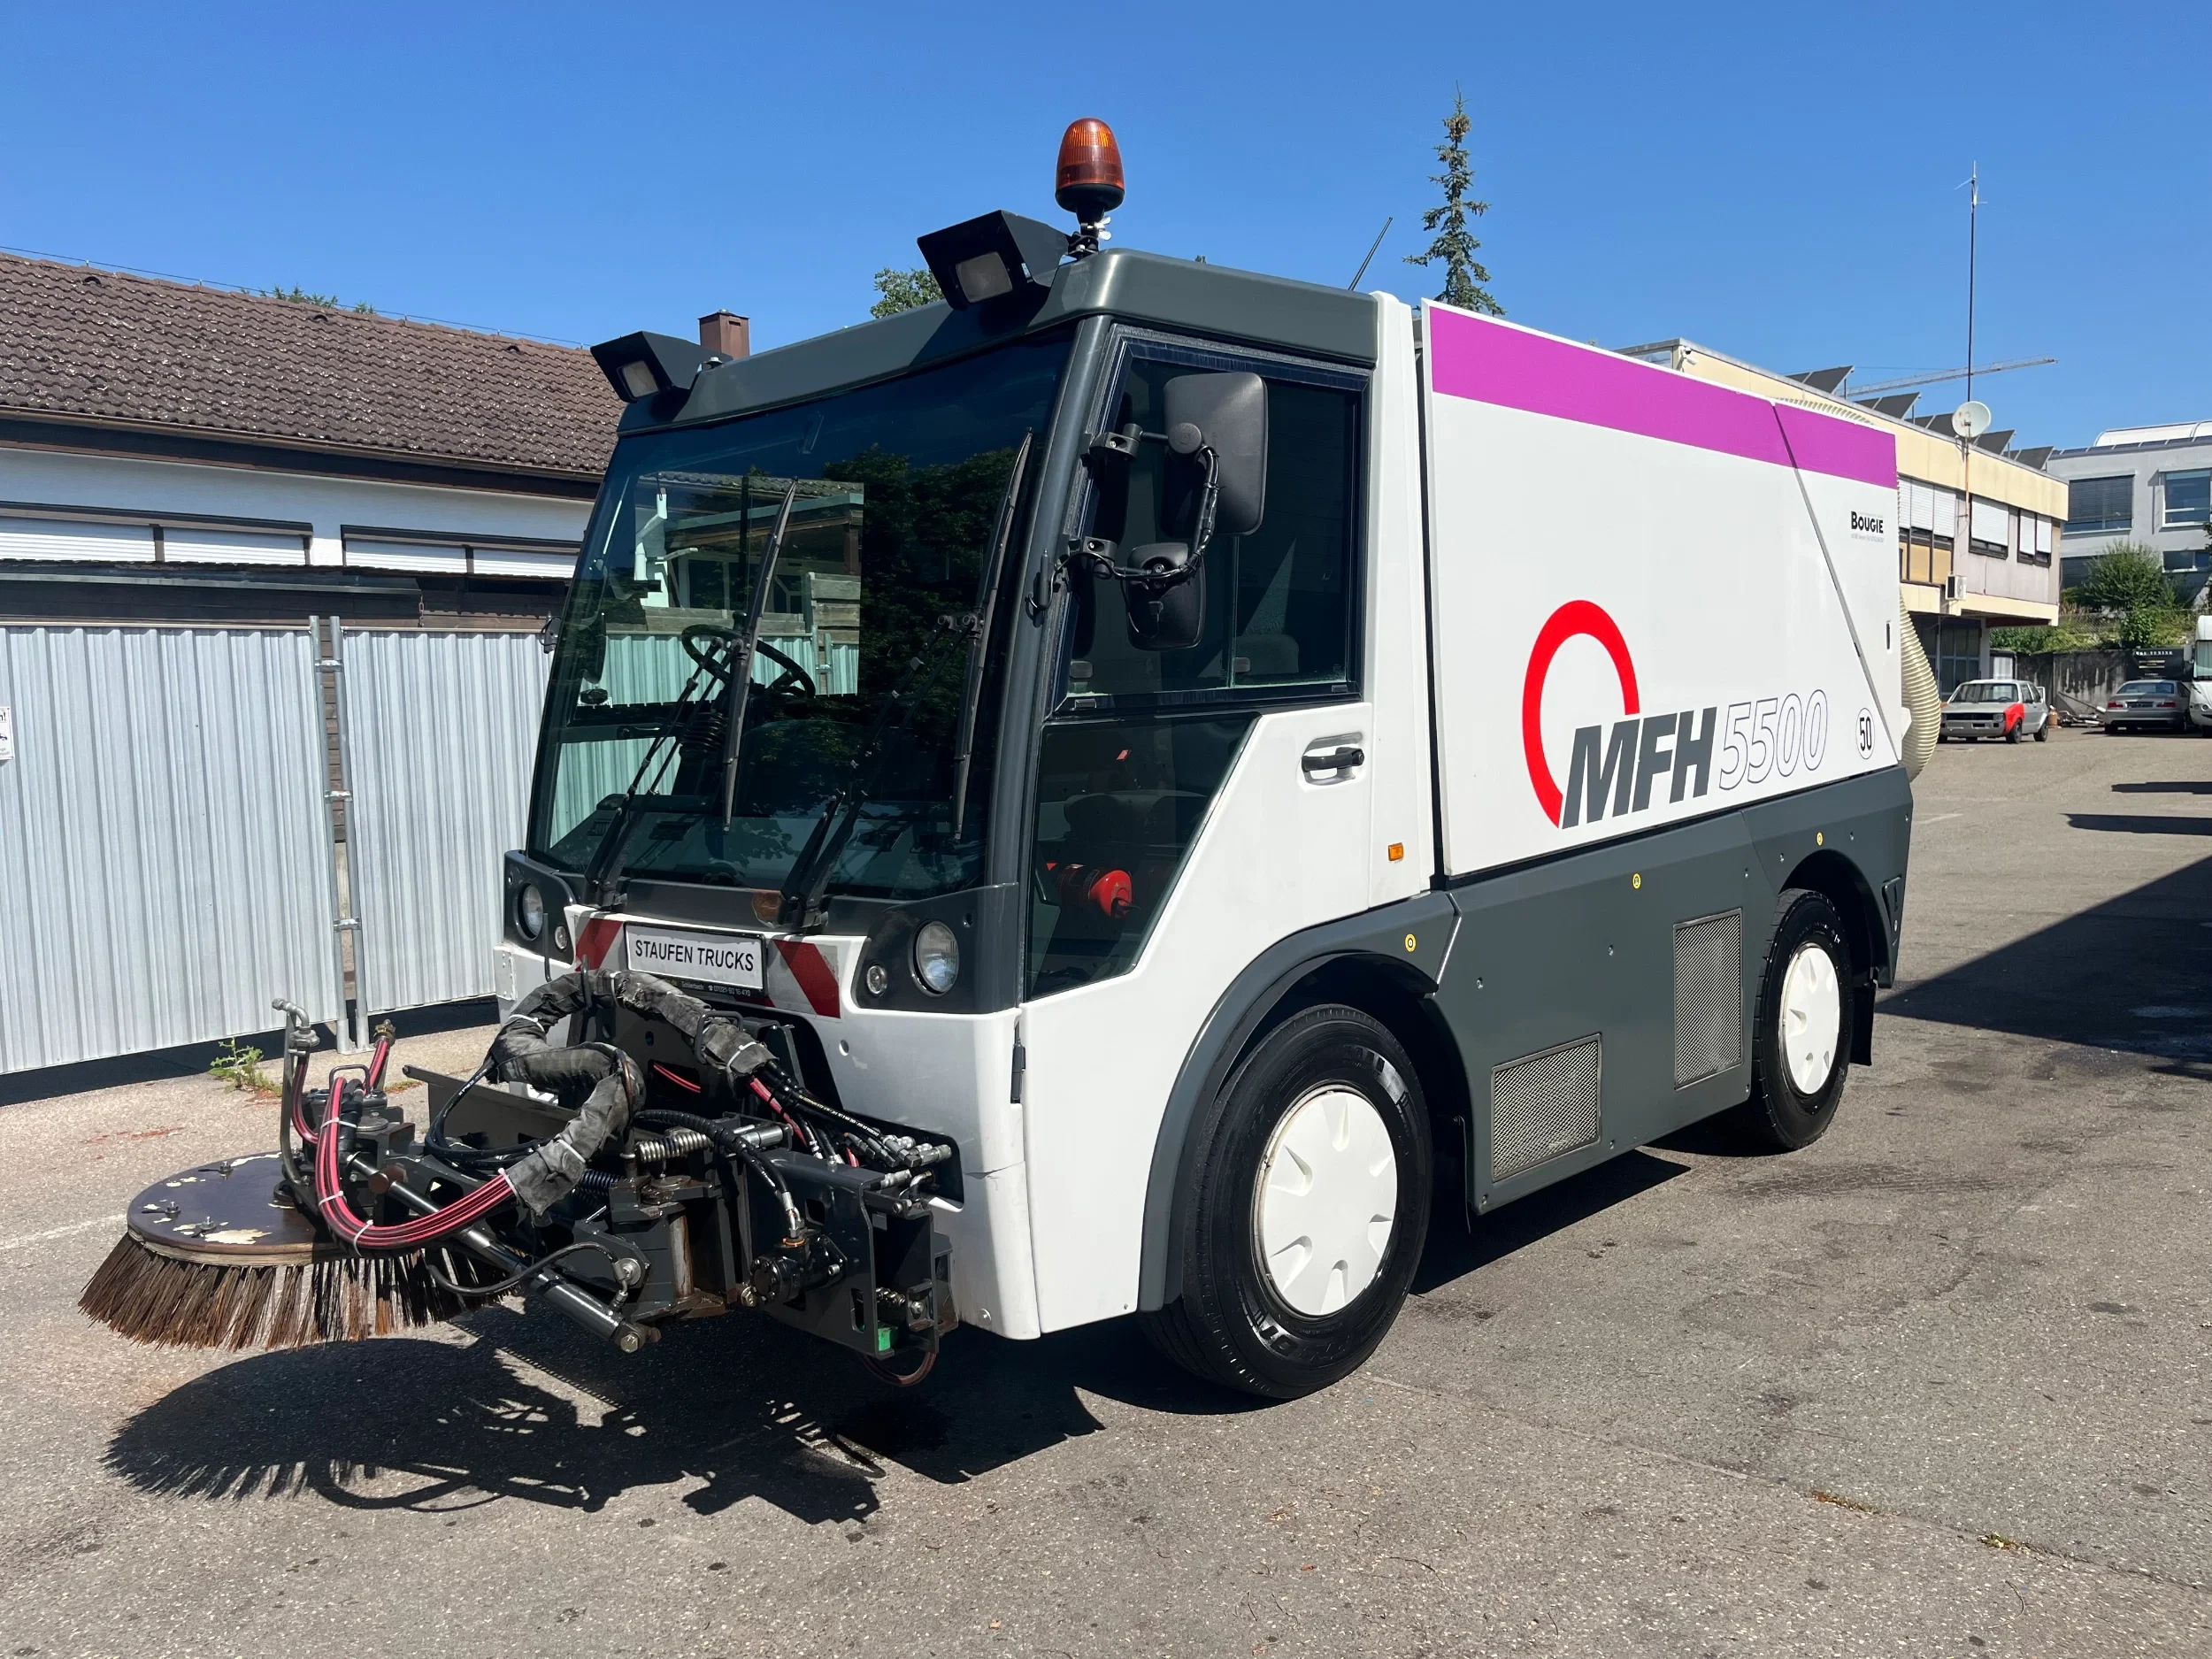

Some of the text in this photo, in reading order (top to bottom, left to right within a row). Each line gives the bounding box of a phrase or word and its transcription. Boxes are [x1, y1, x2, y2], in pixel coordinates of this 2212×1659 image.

[1860, 716, 1872, 751] 50
[1562, 688, 1828, 829] MFH 5500
[635, 939, 754, 972] STAUFEN TRUCKS
